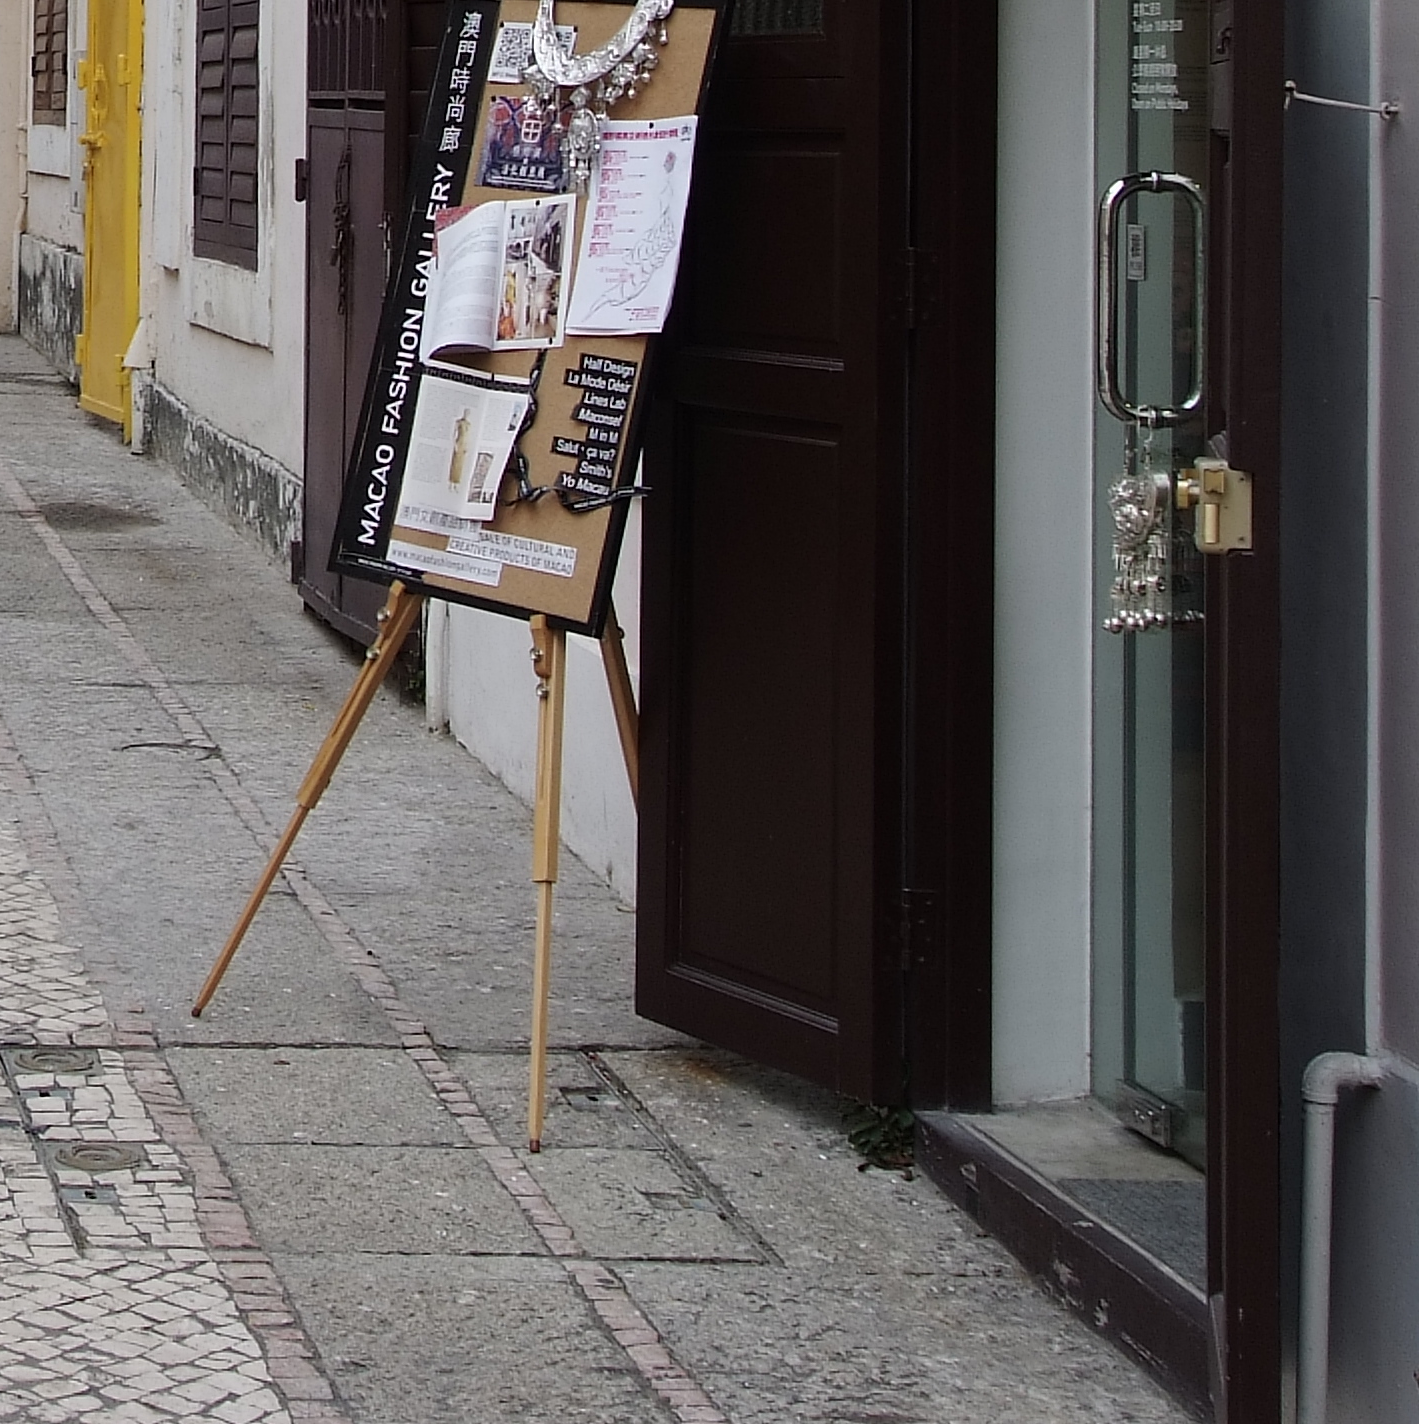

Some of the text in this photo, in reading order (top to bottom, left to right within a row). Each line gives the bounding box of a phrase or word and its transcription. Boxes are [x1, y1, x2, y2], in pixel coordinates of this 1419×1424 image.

[438, 11, 483, 154] 澳門時尚廊
[567, 371, 579, 384] La
[580, 373, 606, 389] Mode
[603, 360, 635, 378] Design
[584, 392, 626, 410] Lines Lab
[357, 444, 395, 546] MACAO
[381, 308, 425, 435] FASHION
[599, 448, 616, 462] va?
[562, 473, 611, 496] Yo Macau
[449, 539, 574, 575] CREATIVE PRODUCTS OF MACAO
[502, 535, 512, 547] OF
[513, 537, 555, 556] CULTURAL
[556, 546, 576, 560] AND
